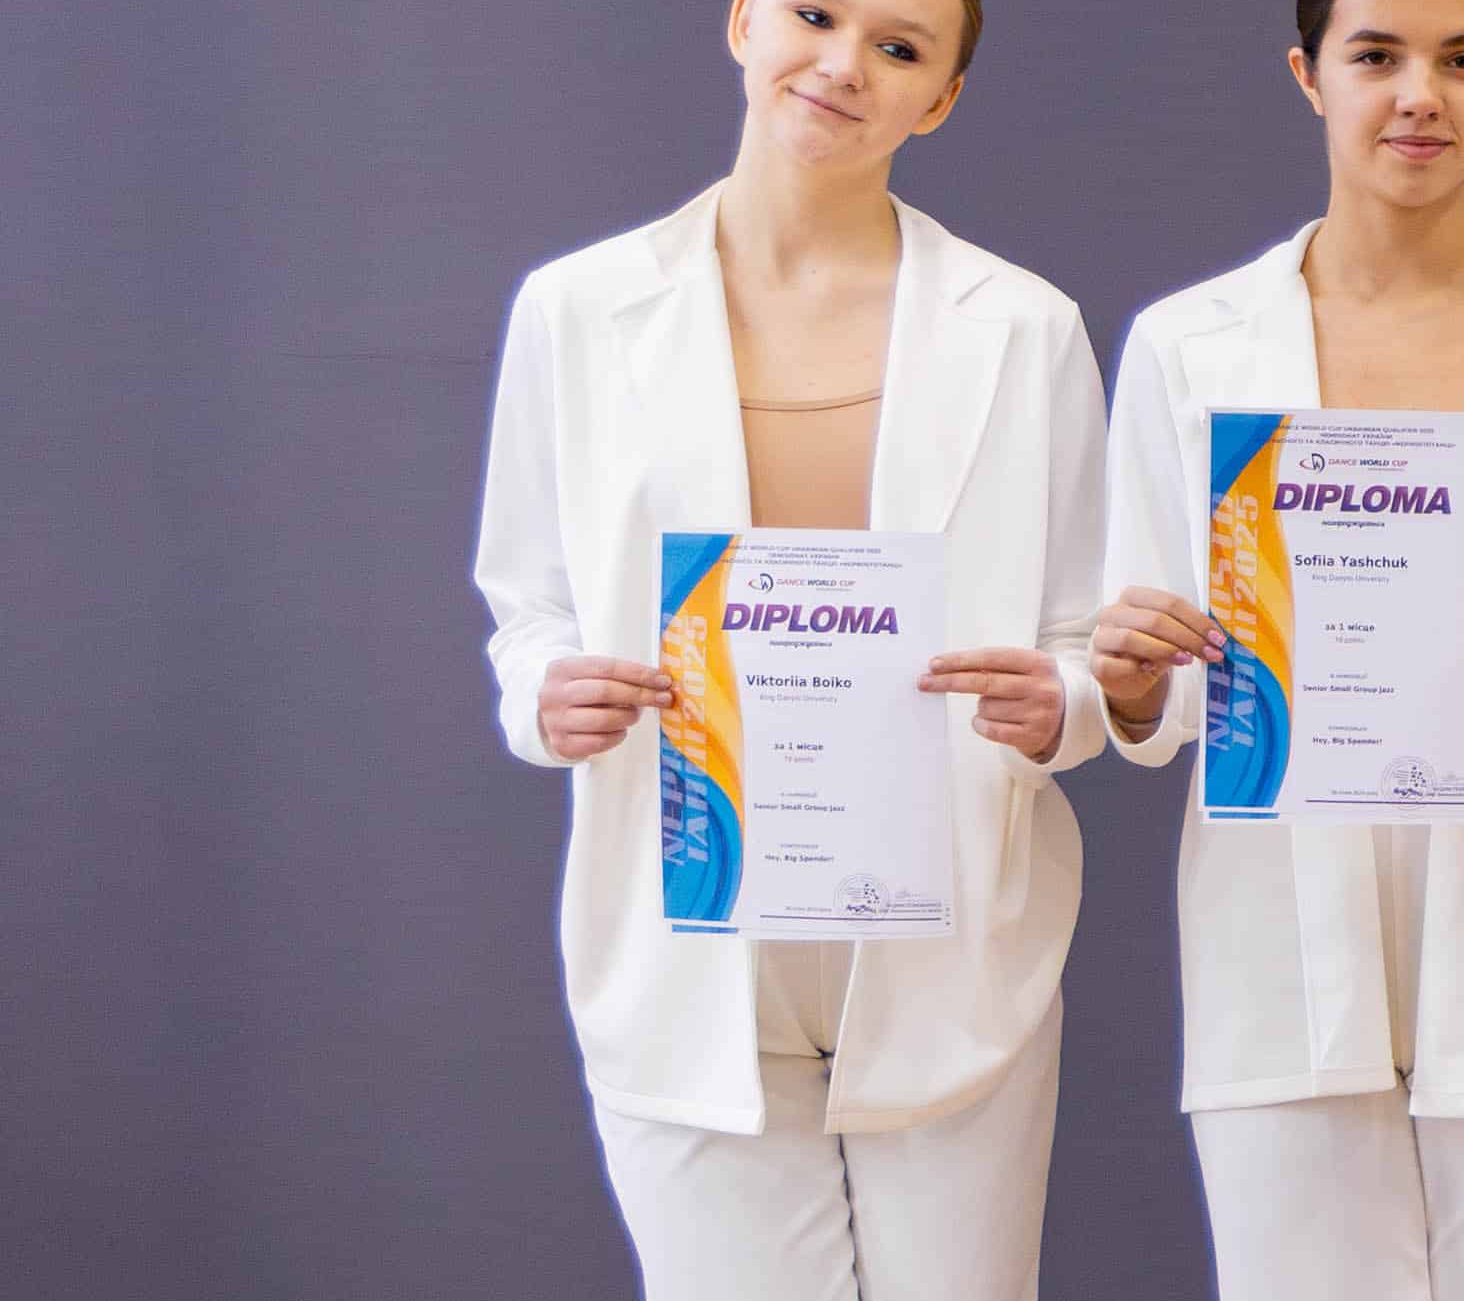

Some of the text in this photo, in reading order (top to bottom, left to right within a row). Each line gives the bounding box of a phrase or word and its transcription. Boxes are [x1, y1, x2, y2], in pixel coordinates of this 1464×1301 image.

[1328, 457, 1357, 466] DANCE
[1273, 484, 1451, 514] DIPLOMA
[1295, 555, 1408, 569] Sofiia Yashchuk
[776, 578, 806, 586] DANCE
[807, 579, 837, 587] WORLD
[722, 604, 899, 634] DIPLOMA
[746, 675, 852, 689] Viktoriia Boiko
